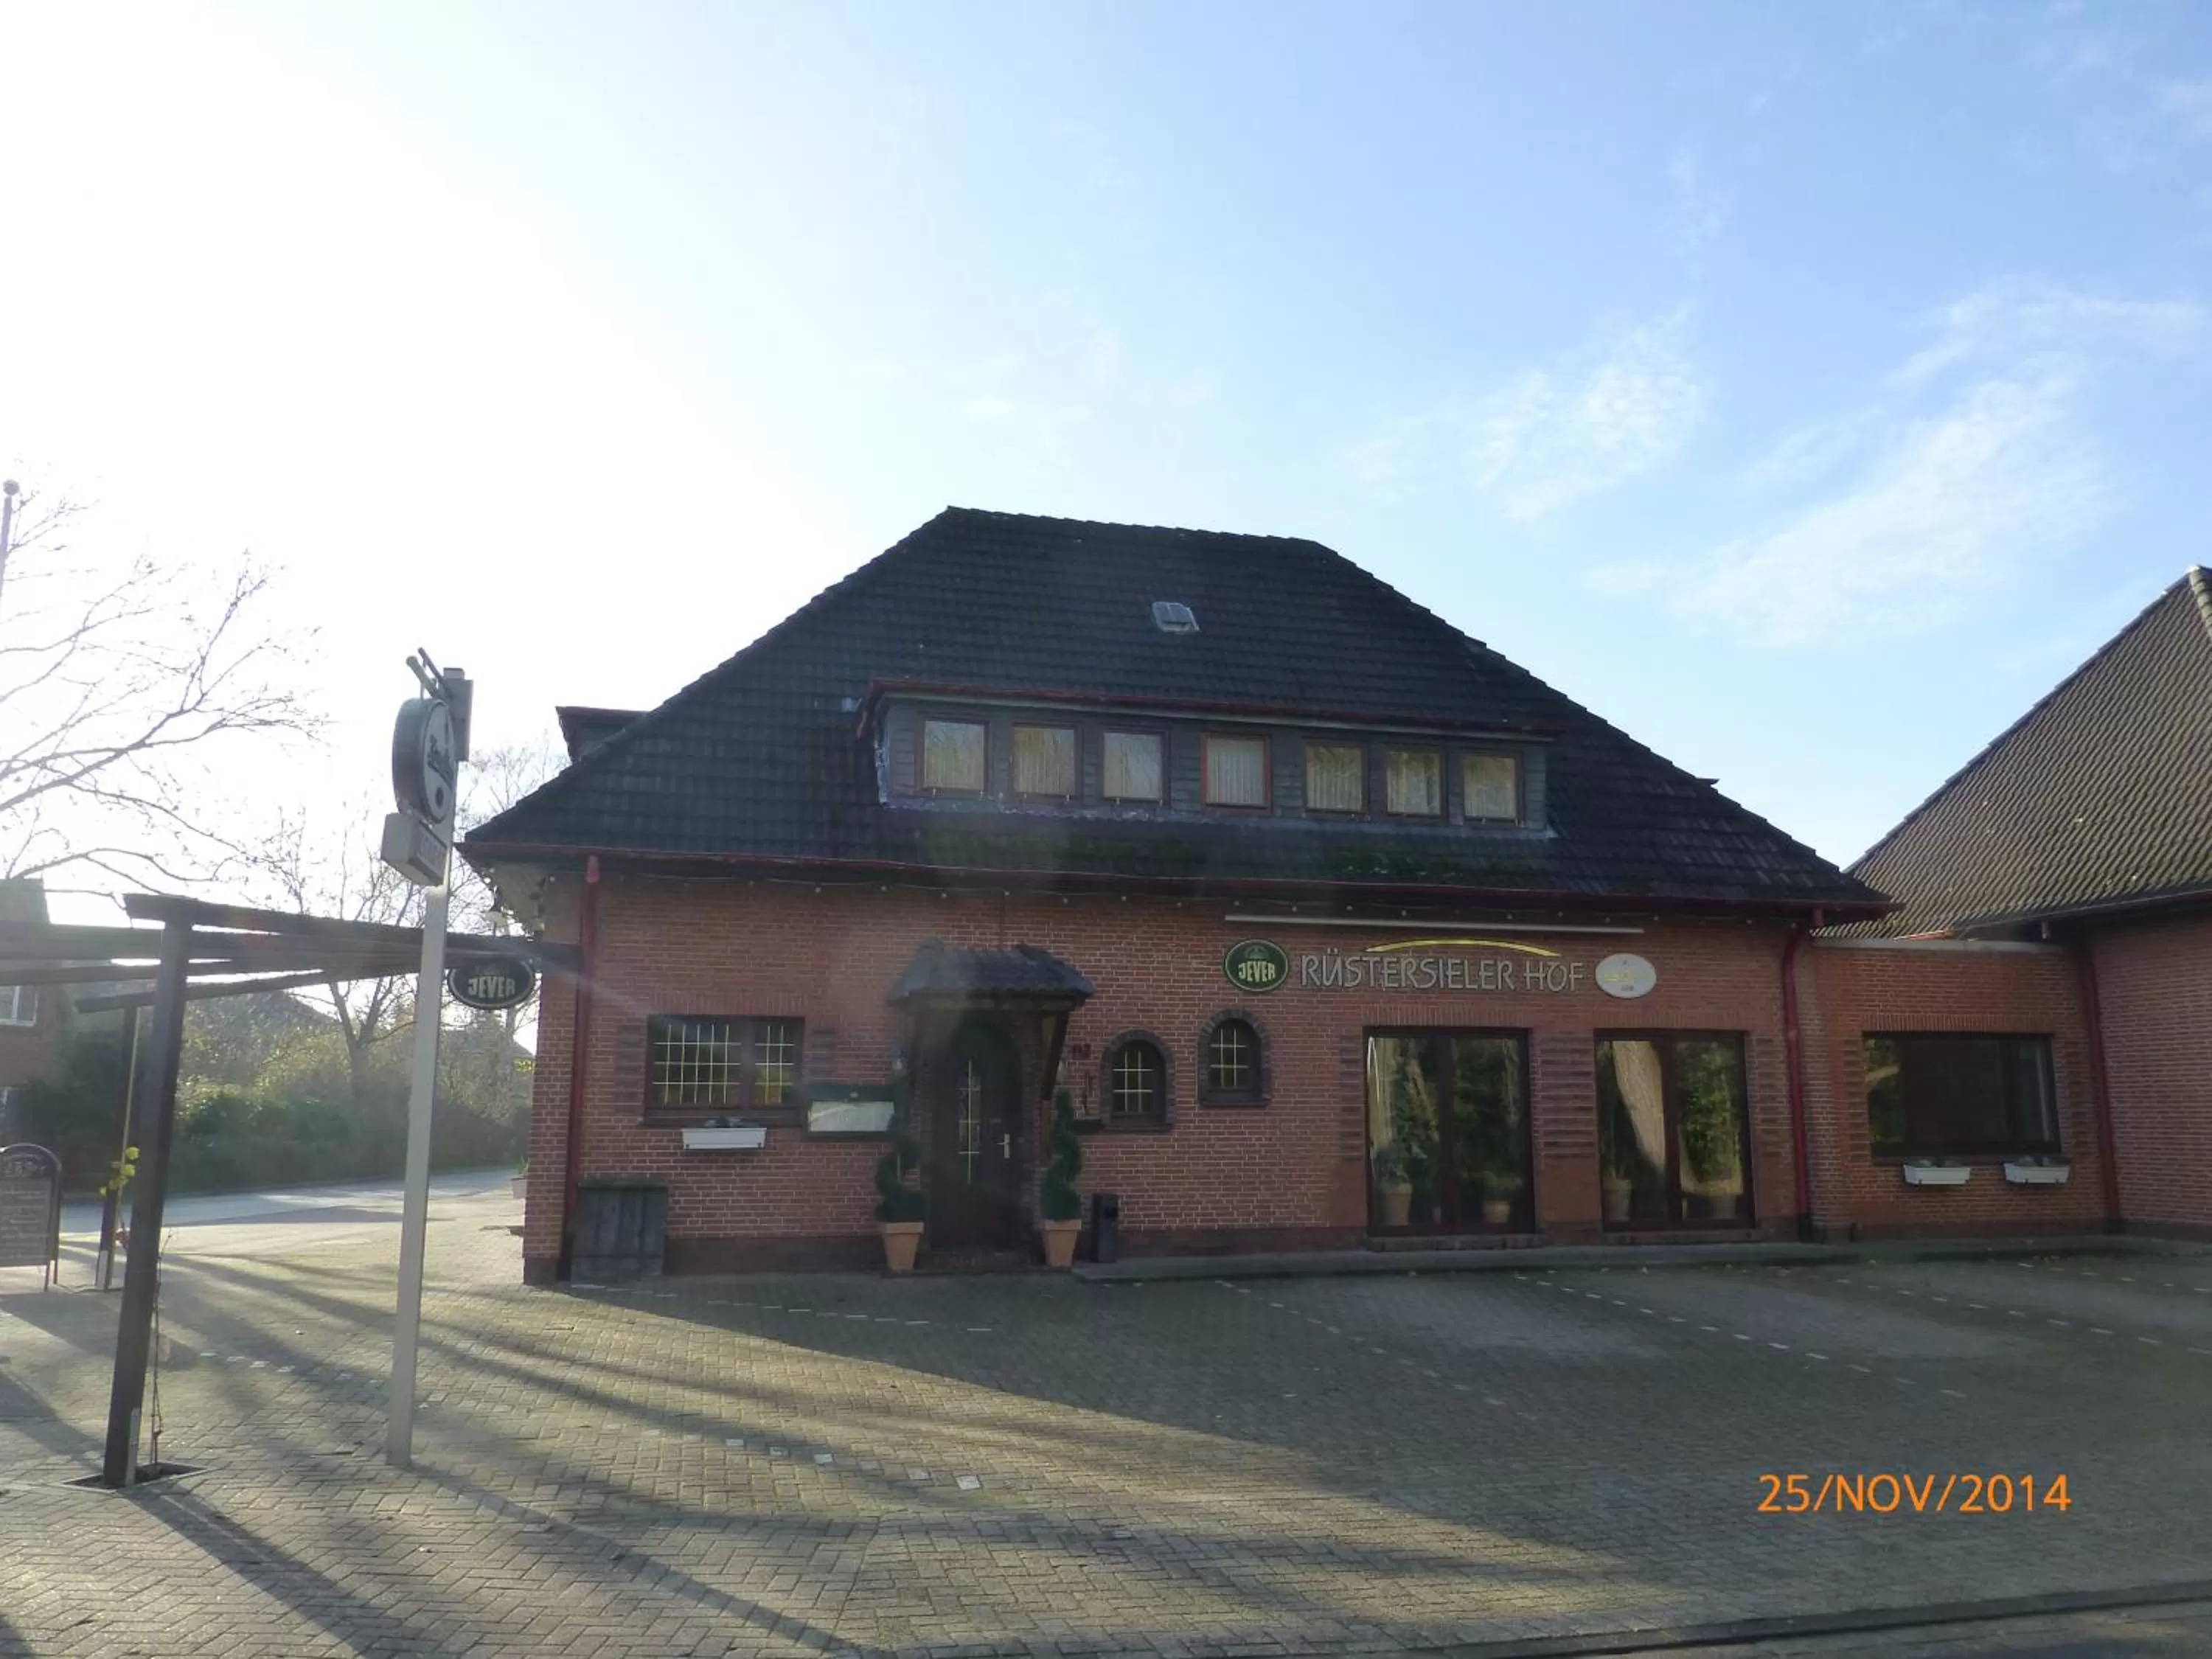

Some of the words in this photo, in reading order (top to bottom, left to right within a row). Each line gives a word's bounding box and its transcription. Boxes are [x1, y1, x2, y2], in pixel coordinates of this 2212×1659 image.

[1238, 961, 1276, 983] JEVER
[1302, 947, 1515, 990] RÜSTERSIELER
[1523, 961, 1584, 992] HOF
[468, 975, 516, 998] JEVER
